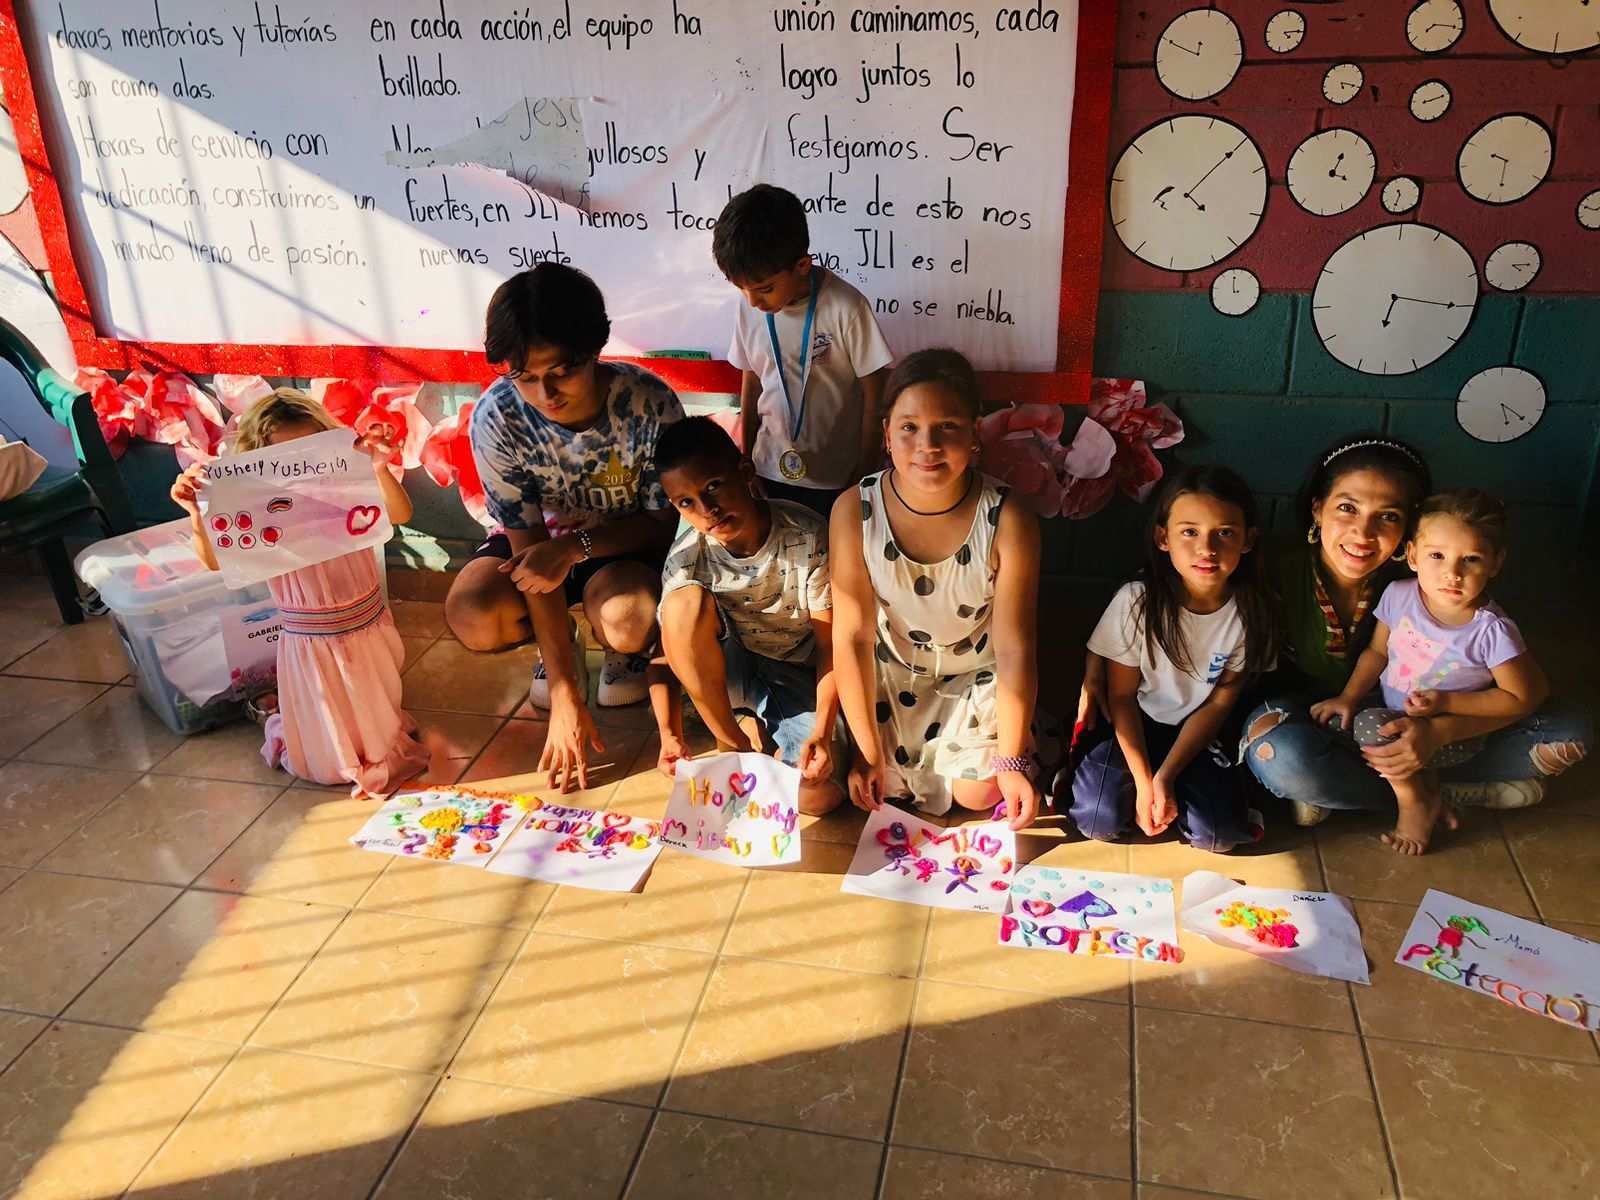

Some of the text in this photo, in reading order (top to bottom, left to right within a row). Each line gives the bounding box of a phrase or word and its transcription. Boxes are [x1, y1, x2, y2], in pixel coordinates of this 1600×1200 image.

[233, 25, 245, 57] y
[253, 1, 337, 43] tutorías
[370, 18, 396, 42] en
[411, 0, 463, 40] cada
[586, 14, 653, 50] equipo
[673, 0, 702, 36] ha
[774, 0, 1059, 39] unión caminamos, cada
[68, 58, 215, 99] son como alas.
[379, 53, 461, 97] brillado.
[780, 42, 975, 103] logro juntos lo
[78, 107, 328, 160] Horas de servicio con
[787, 106, 1013, 173] festejamos. Ser
[695, 148, 706, 180] y
[212, 166, 339, 211] construimos
[353, 195, 376, 211] un
[803, 171, 1031, 230] arte de esto nos
[112, 219, 367, 276] mundo lleno de pasión.
[419, 247, 489, 268] nuevas
[854, 228, 894, 269] JLI
[911, 254, 934, 271] es
[950, 239, 968, 274] el
[875, 288, 1016, 326] no se niebla.
